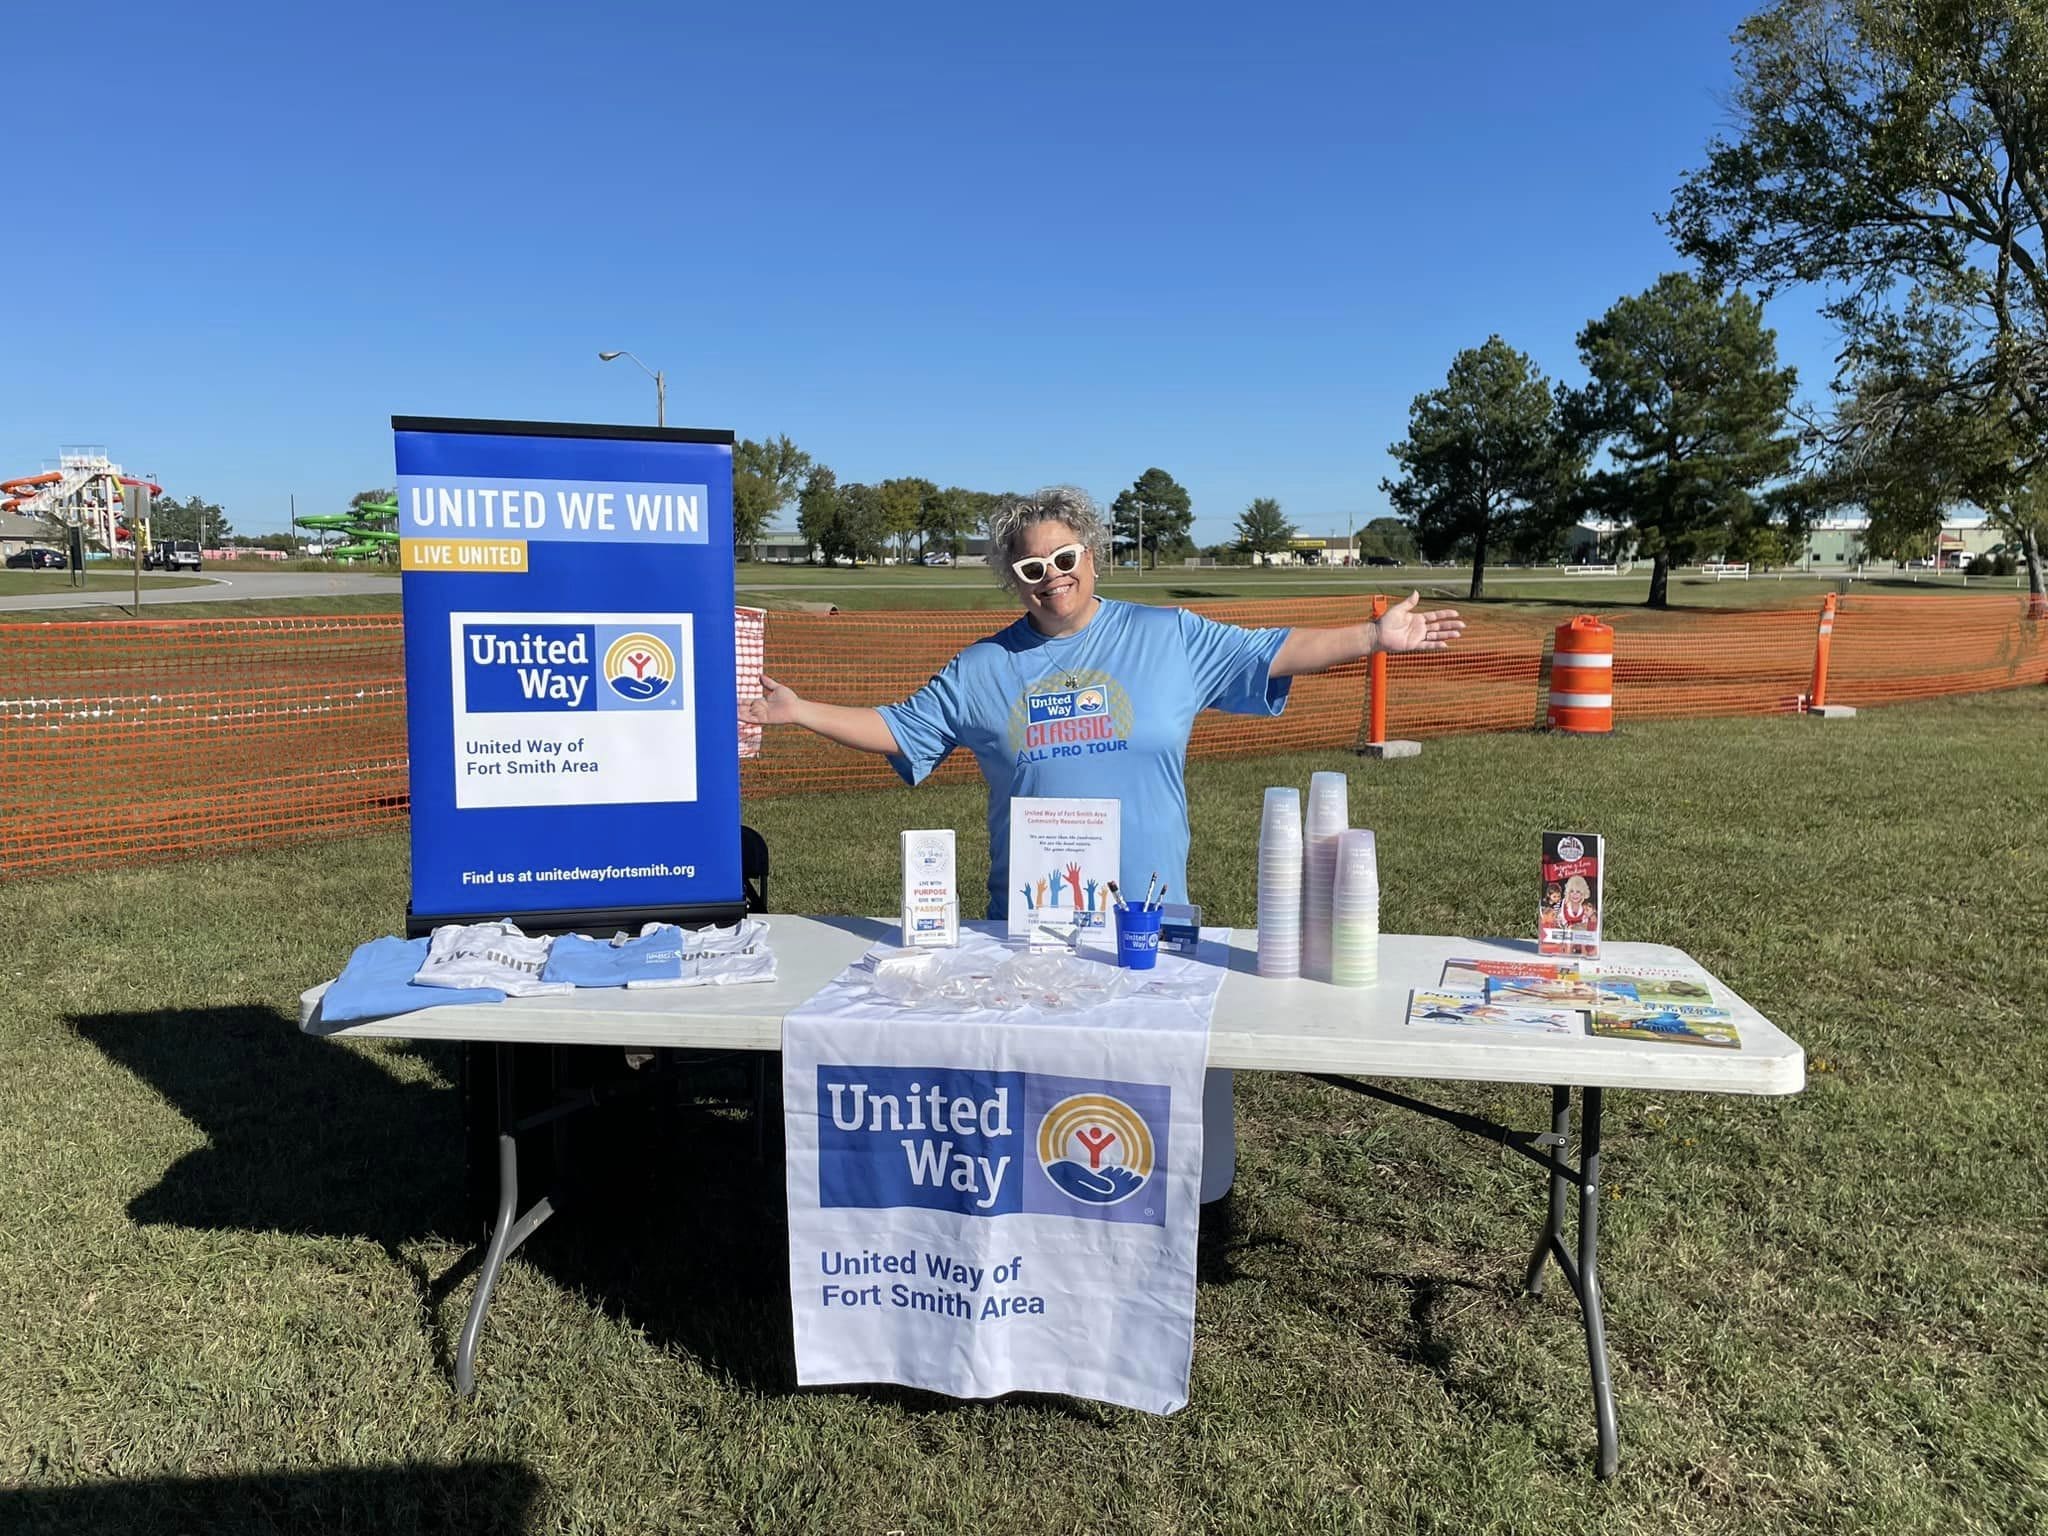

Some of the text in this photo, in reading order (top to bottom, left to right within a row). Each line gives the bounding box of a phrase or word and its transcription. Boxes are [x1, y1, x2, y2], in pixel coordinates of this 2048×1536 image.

[411, 486, 700, 533] UNITED WE WIN
[413, 545, 523, 567] LIVE UNITED
[469, 632, 589, 666] United
[517, 668, 589, 708] Way
[1030, 694, 1072, 709] United
[1047, 704, 1072, 717] Way
[1026, 714, 1114, 749] CLASSIC
[466, 737, 585, 756] United Way of
[1016, 739, 1128, 768] ALL PRO TOUR
[466, 760, 599, 776] Fort Smith Area
[1024, 809, 1107, 818] United Way of Fort Smith Area
[1027, 817, 1104, 826] Community Resource Guide
[462, 863, 696, 886] Find us at unitedwayfortsmith.org
[913, 888, 948, 896] PURPOSE
[1124, 934, 1147, 943] United
[1132, 941, 1147, 951] Way
[826, 1082, 1012, 1138] United
[901, 1138, 1011, 1209] Way
[821, 1250, 1023, 1291] United Way of
[822, 1283, 1046, 1321] Fort Smith Area
